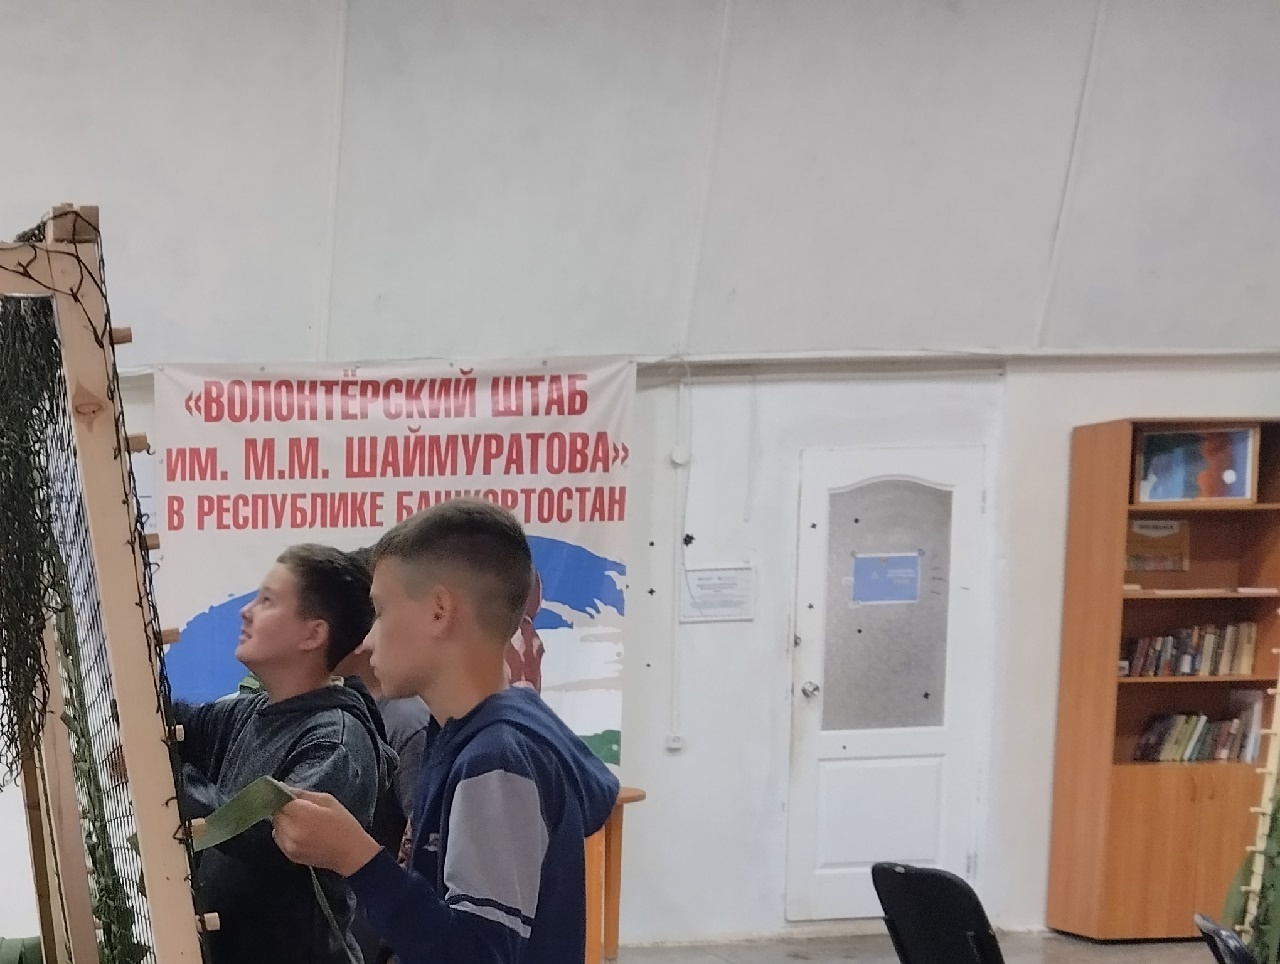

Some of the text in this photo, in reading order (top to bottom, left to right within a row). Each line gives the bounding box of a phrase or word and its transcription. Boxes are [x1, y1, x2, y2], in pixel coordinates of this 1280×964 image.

[184, 368, 589, 424] «ВОЛОНТЁРСКИЙ ШТАБ
[165, 425, 630, 482] ИМ. М.М. ШАЙМУРАТОВА»
[166, 495, 185, 531] В
[196, 491, 384, 531] РЕСПУБЛИКЕ
[396, 486, 627, 525] БАРТОСТАН
